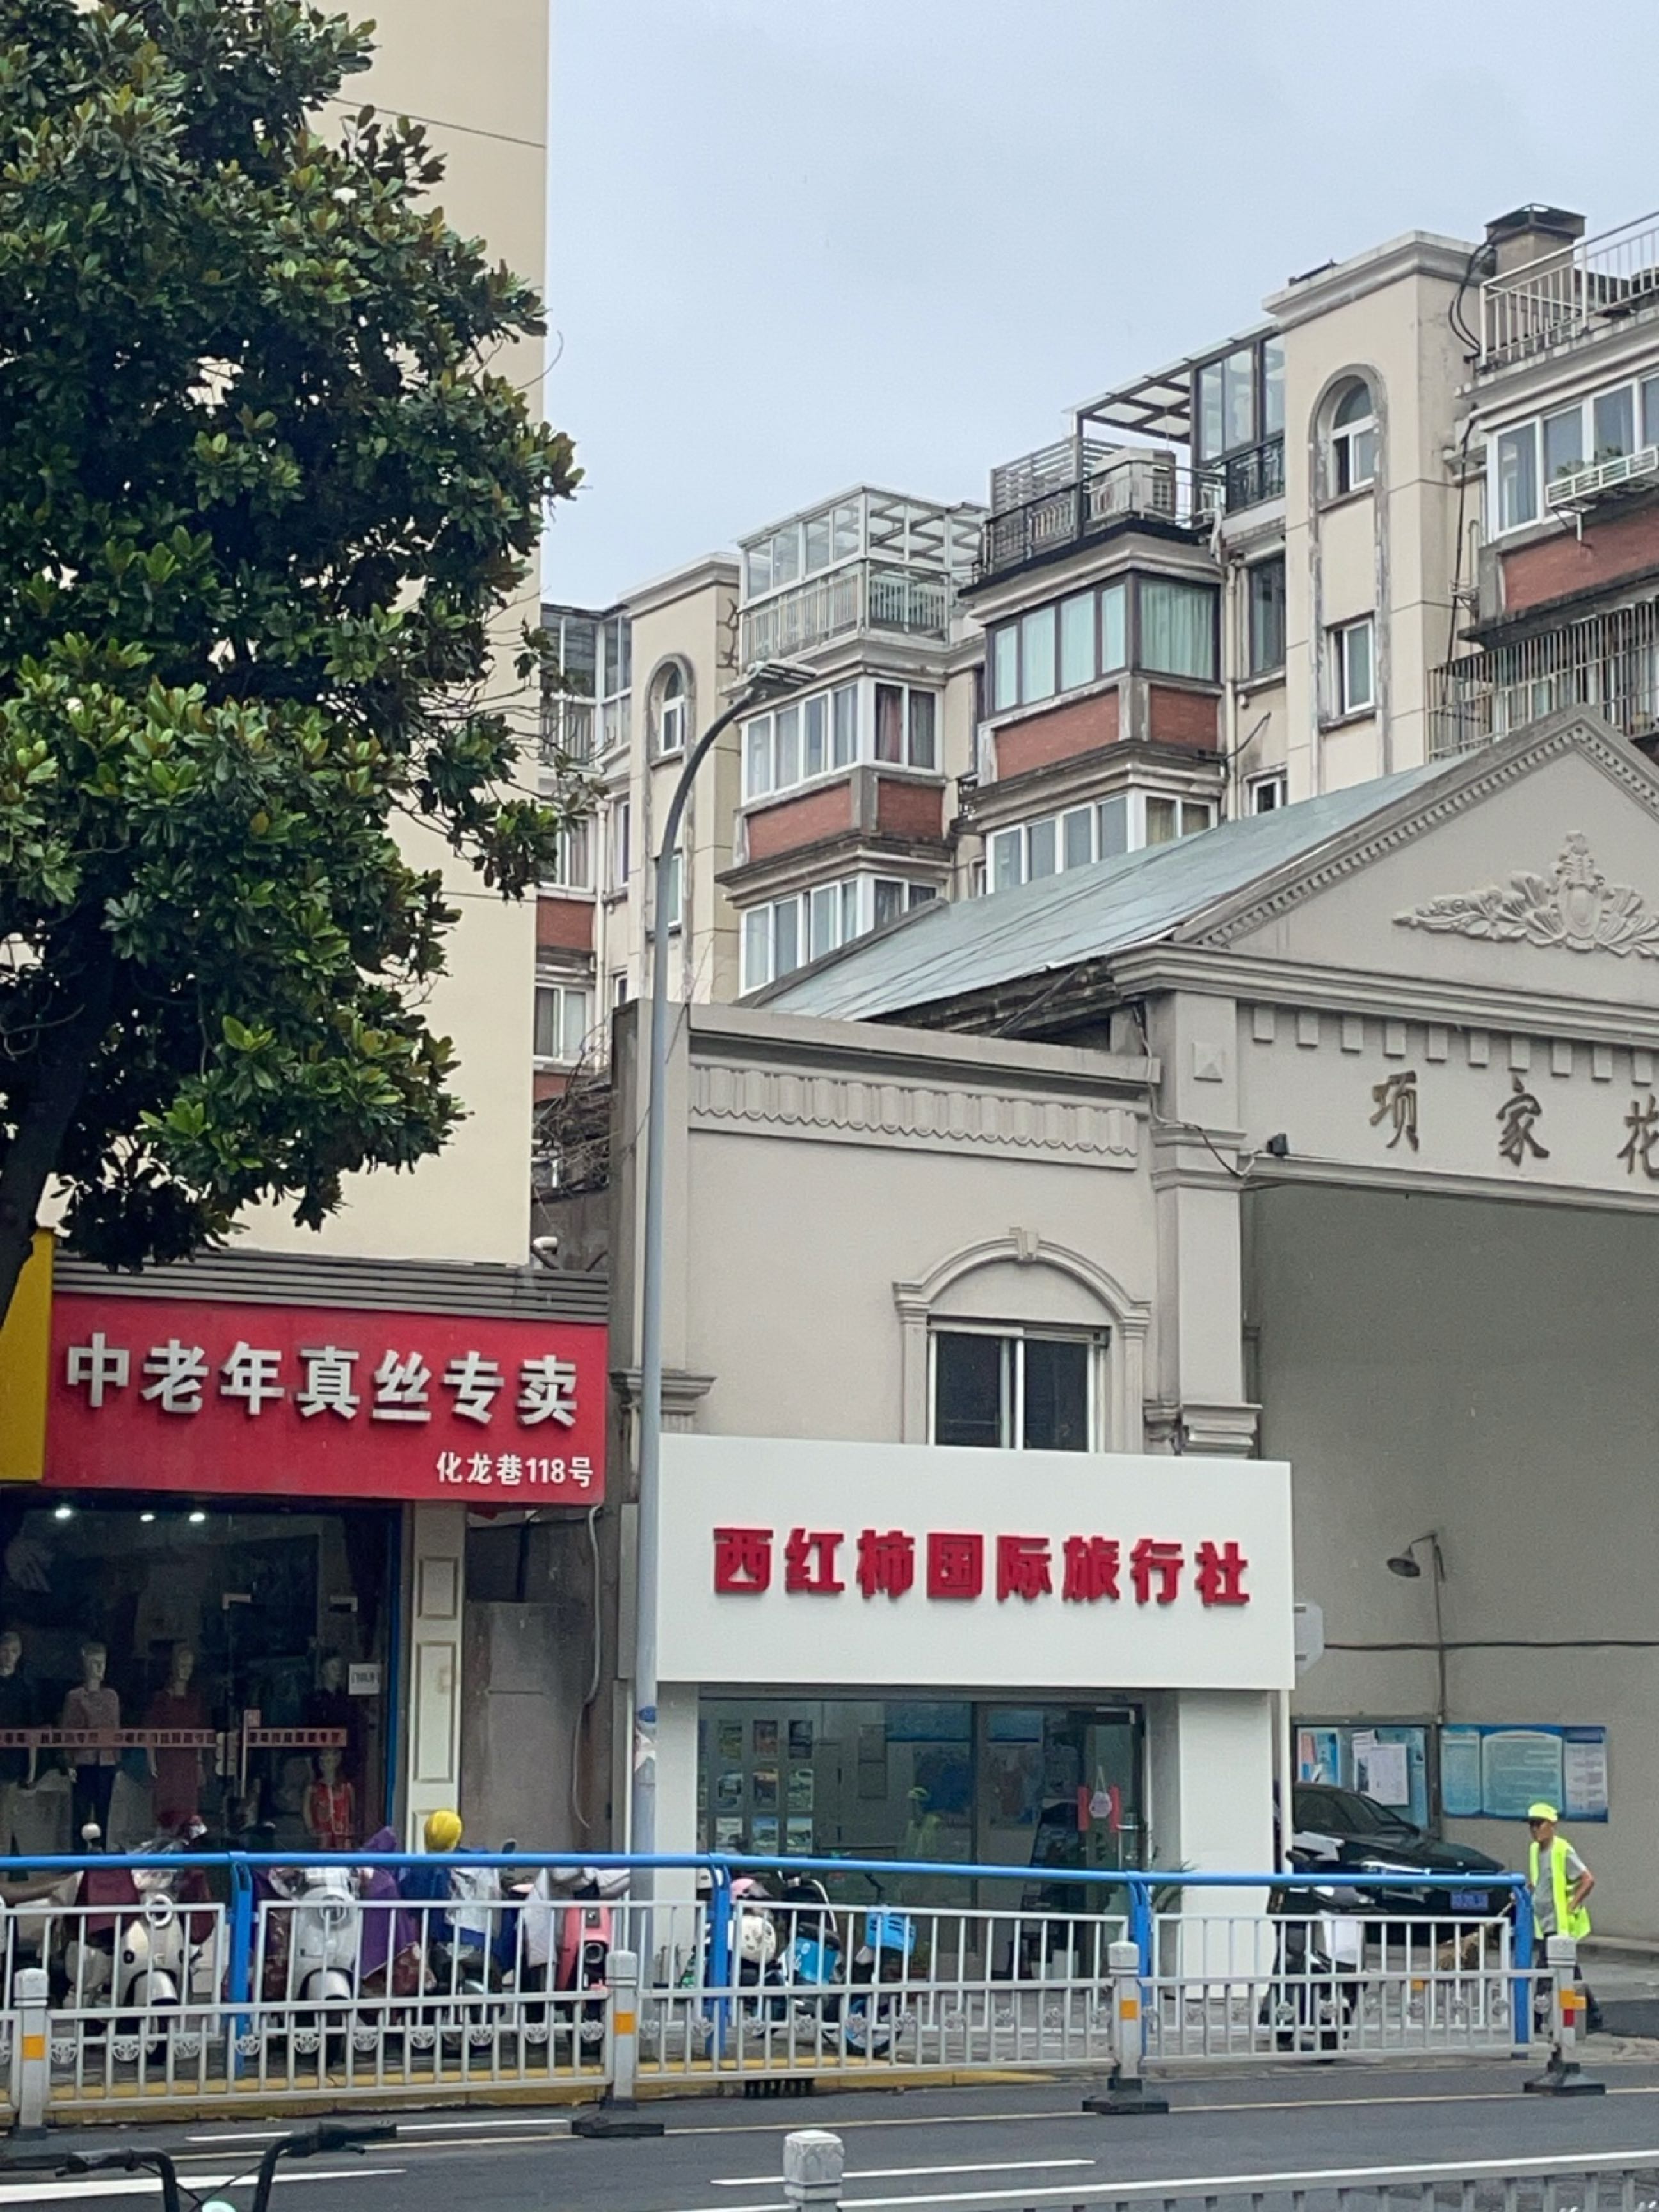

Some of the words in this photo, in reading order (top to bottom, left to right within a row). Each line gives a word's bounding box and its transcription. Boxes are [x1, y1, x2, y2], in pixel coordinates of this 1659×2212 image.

[67, 1333, 577, 1427] 中老年真丝专卖
[437, 1451, 594, 1489] 化龙巷118号
[713, 1527, 1250, 1605] 西红柿国际旅行社
